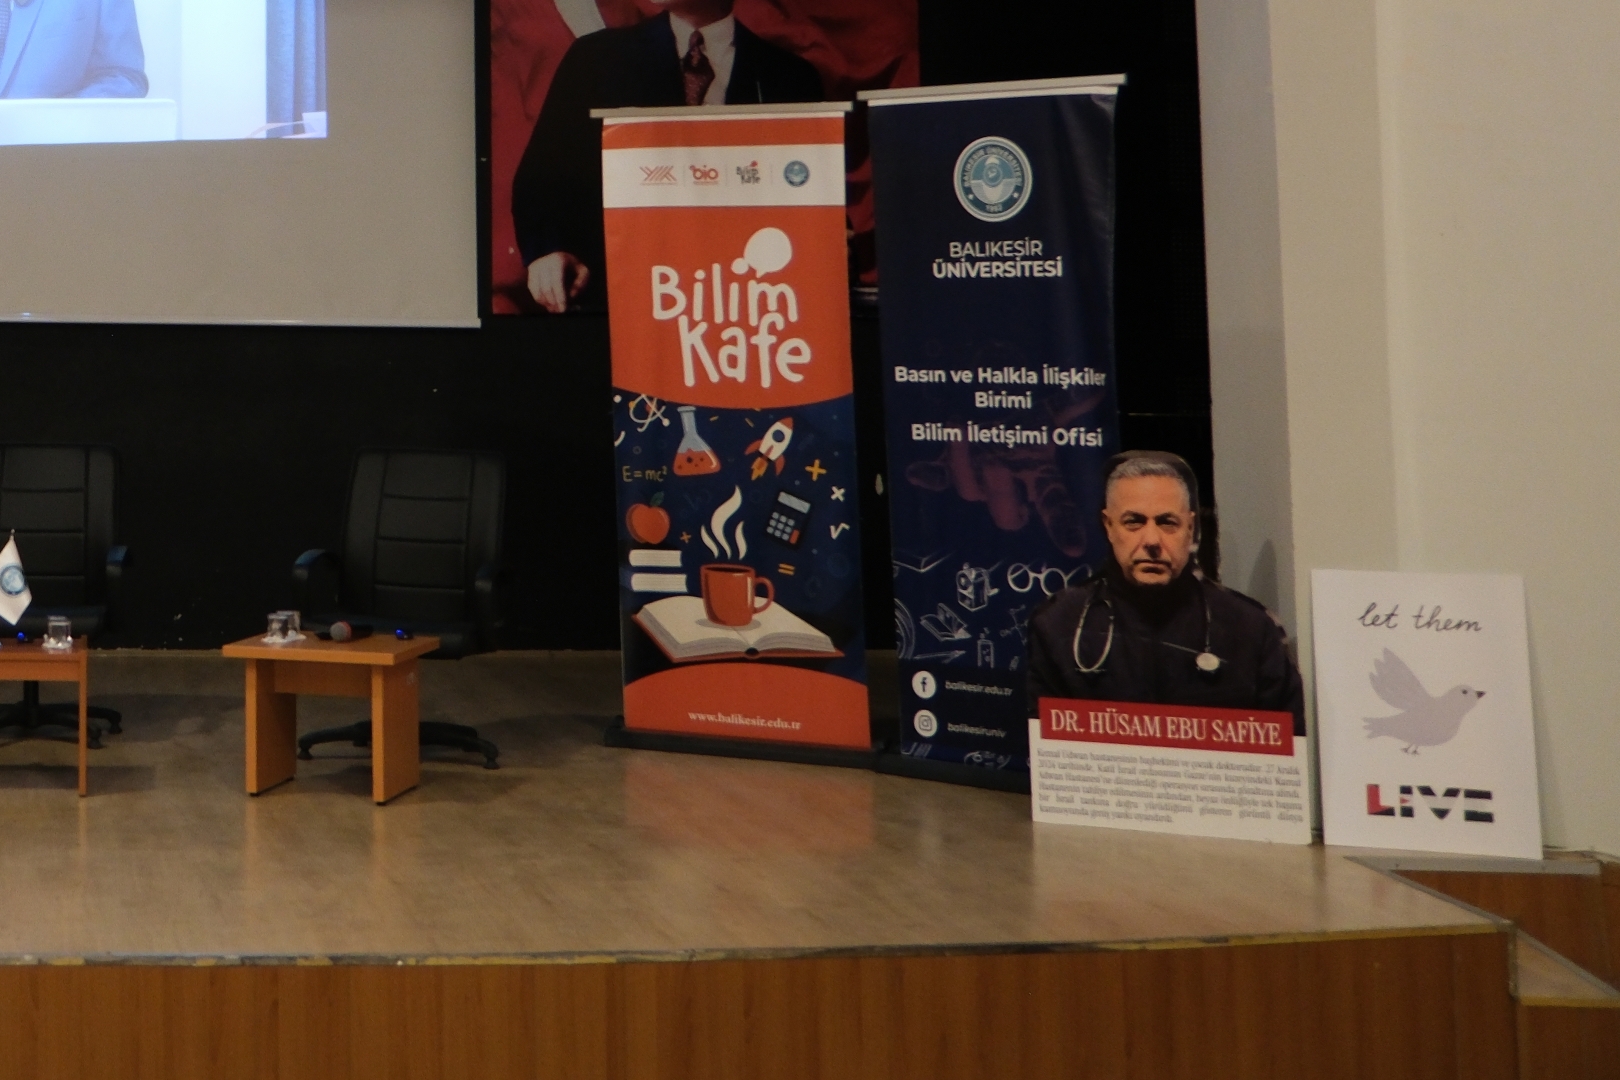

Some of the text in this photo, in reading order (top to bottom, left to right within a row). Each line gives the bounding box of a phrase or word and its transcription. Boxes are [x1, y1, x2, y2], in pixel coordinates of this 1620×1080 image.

[949, 236, 1042, 259] BALIKESİR
[932, 254, 1063, 279] ÜNİVERSİTESİ
[651, 258, 799, 326] Bilim
[678, 312, 812, 389] Kafe
[894, 363, 1107, 390] Basın ve Halkla İlişkiler
[975, 389, 1032, 410] Birimi
[911, 421, 1104, 449] Bilim İletişimi Ofisi
[1358, 602, 1482, 633] let them
[687, 711, 802, 731] www.balikesir.edu.tr
[1050, 707, 1282, 747] DR. HÜSAM EBU SAFİYE
[1366, 783, 1494, 823] LIVE
